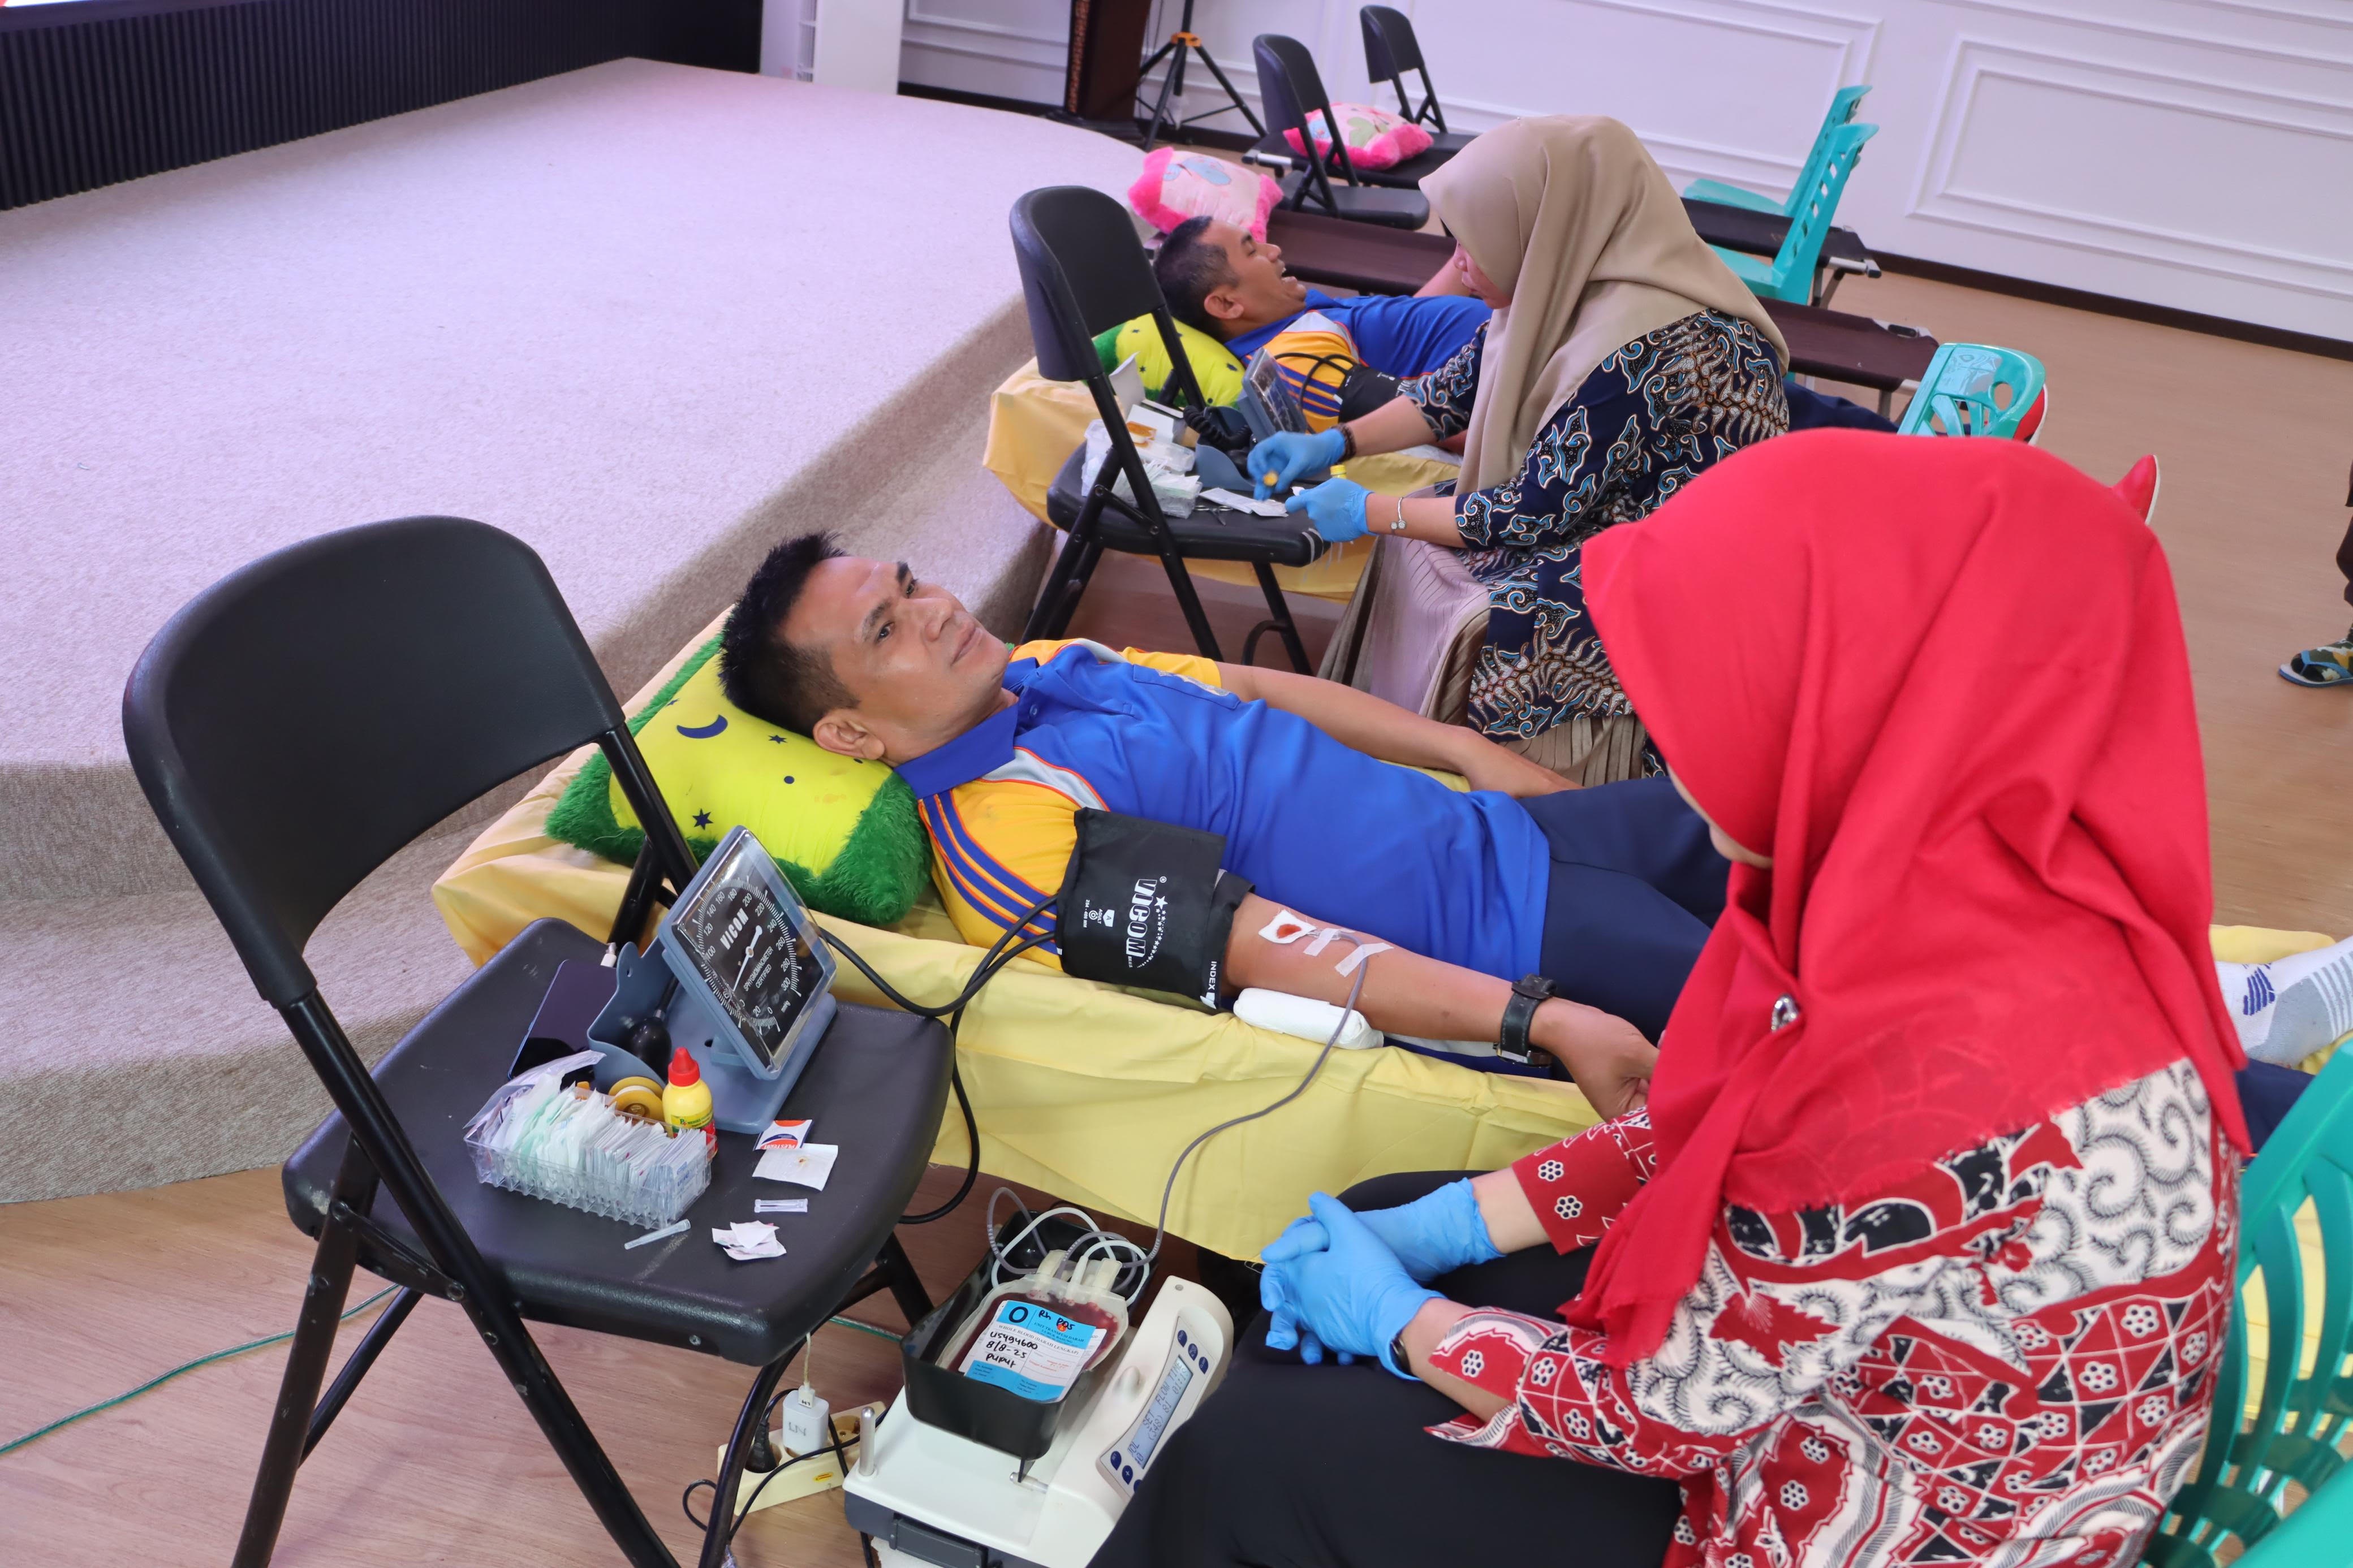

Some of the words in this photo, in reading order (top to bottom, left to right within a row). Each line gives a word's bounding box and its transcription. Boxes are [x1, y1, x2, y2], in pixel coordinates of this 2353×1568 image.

[716, 891, 725, 904] 160
[728, 888, 737, 901] 180
[743, 893, 752, 907] 200
[706, 904, 717, 917] 140
[755, 903, 764, 917] 220
[1126, 879, 1157, 957] VICOM
[704, 922, 713, 936] 120
[720, 908, 749, 950] VICOM
[767, 919, 777, 933] 240
[776, 937, 785, 951] 260
[706, 945, 716, 961] 100
[743, 947, 774, 991] SPHYGMOMANOMETER
[781, 958, 790, 972] 280
[756, 964, 772, 988] CERTIFIED
[1208, 961, 1217, 990] INDEX
[781, 977, 790, 991] 300
[753, 1005, 761, 1017] 20
[1009, 1306, 1028, 1323] O
[1038, 1310, 1051, 1320] Rh
[1017, 1330, 1035, 1339] BLOOD
[1143, 1409, 1155, 1429] SET
[1155, 1381, 1170, 1405] FLOW
[1167, 1362, 1182, 1380] TIME
[1163, 1401, 1171, 1413] 81
